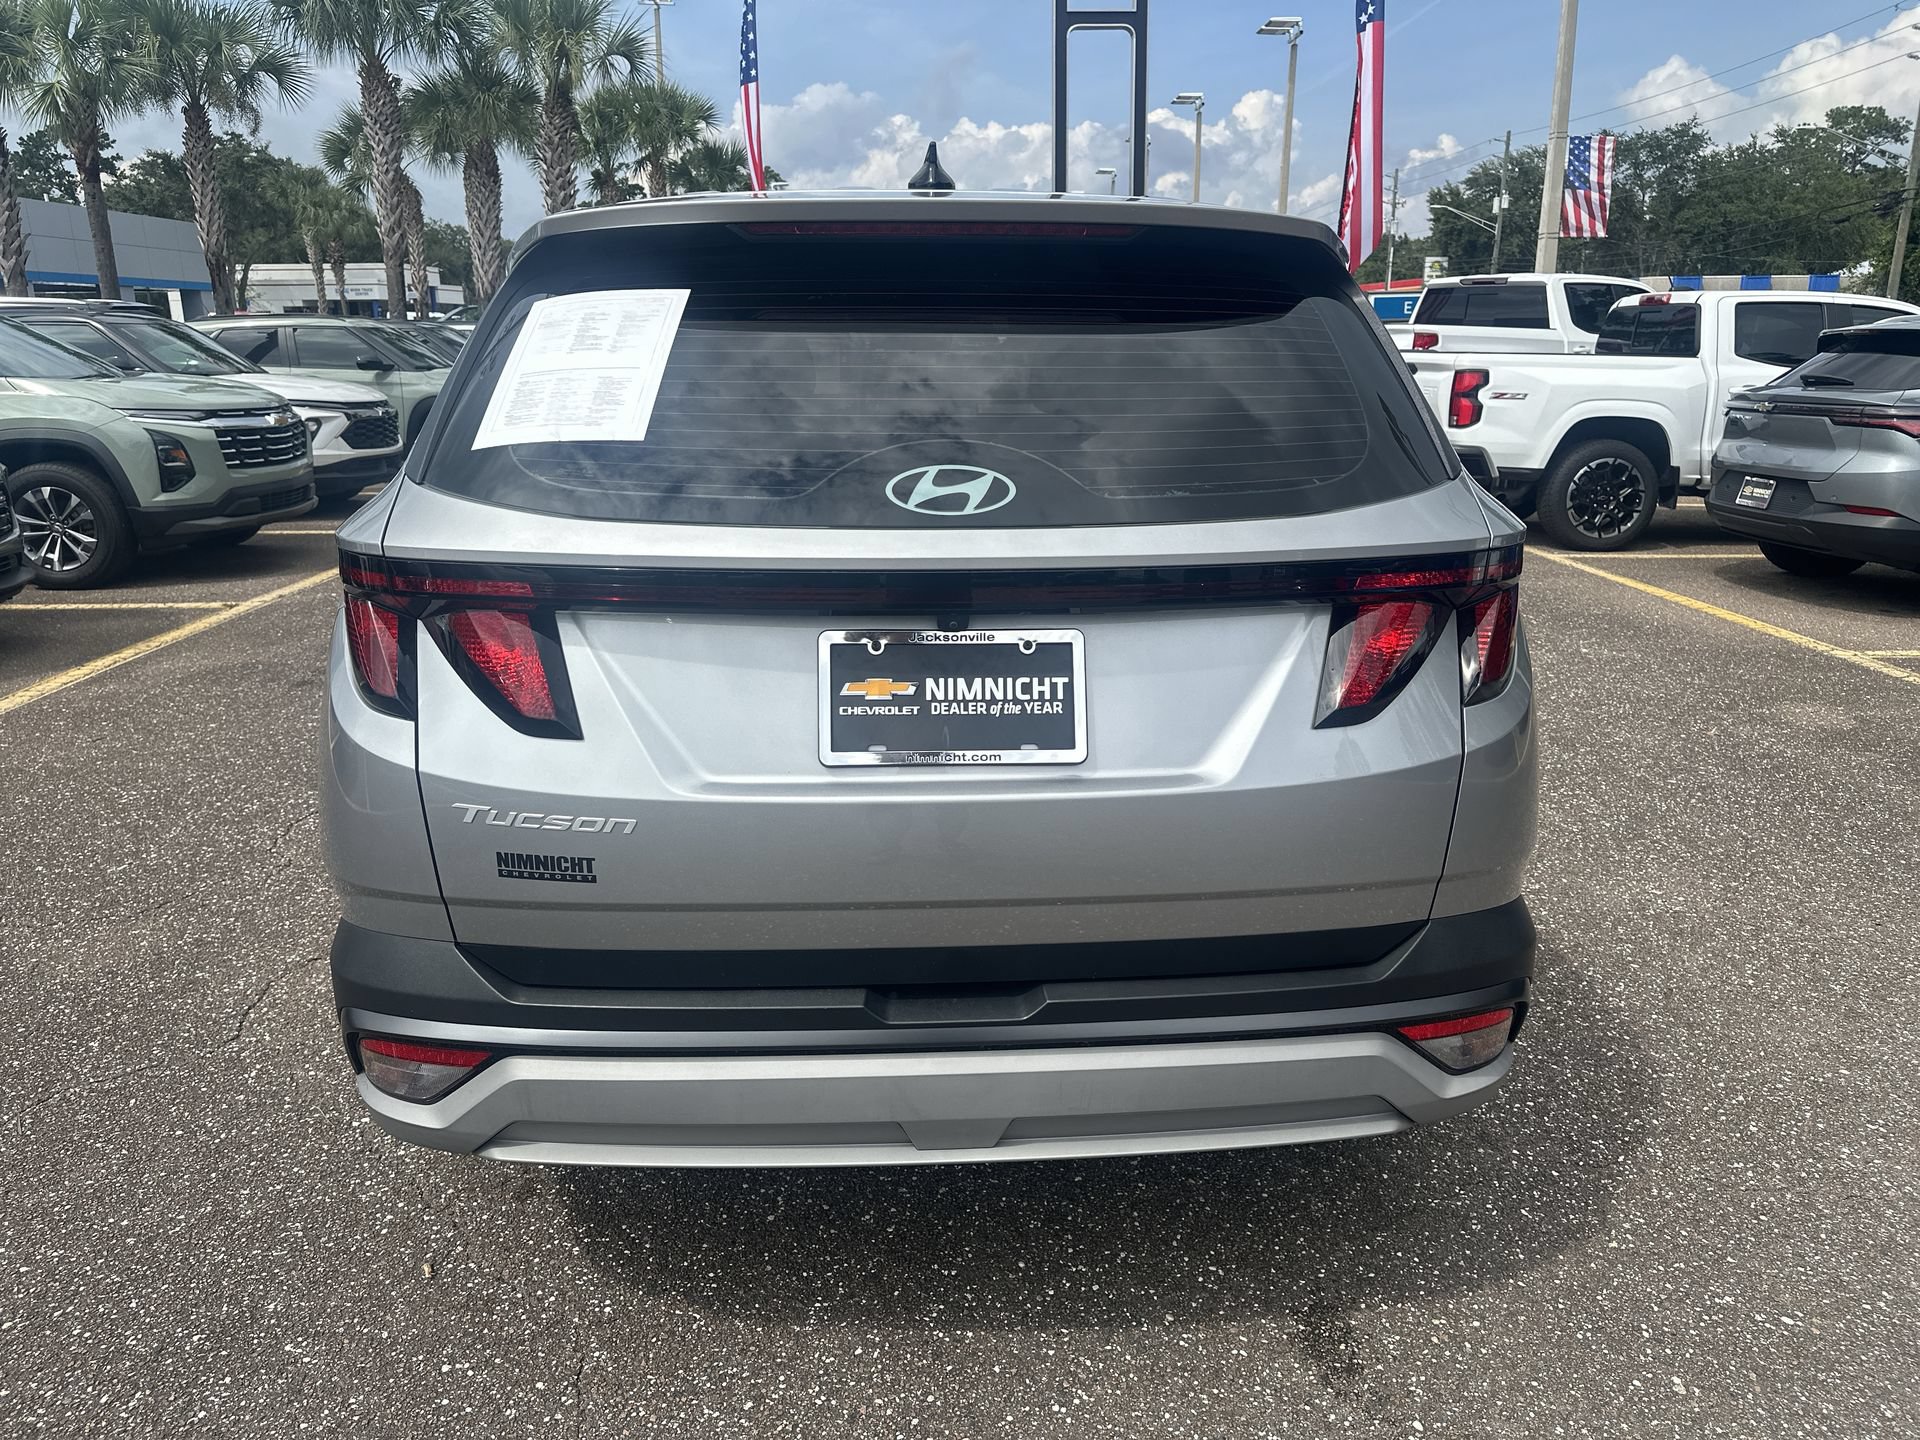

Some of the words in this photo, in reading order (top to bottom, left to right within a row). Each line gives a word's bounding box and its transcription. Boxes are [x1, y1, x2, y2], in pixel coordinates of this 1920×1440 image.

[908, 632, 996, 643] Jacksonville
[925, 677, 1069, 701] NIMNICHT
[838, 705, 921, 715] CHEVROLET
[931, 702, 987, 715] DEALER
[989, 702, 1003, 717] of
[1003, 702, 1022, 715] the
[1024, 702, 1063, 714] YEAR
[905, 752, 1002, 763] nimnicht.com
[496, 852, 596, 873] NIMNICHT
[502, 870, 594, 881] CHEVROLET
